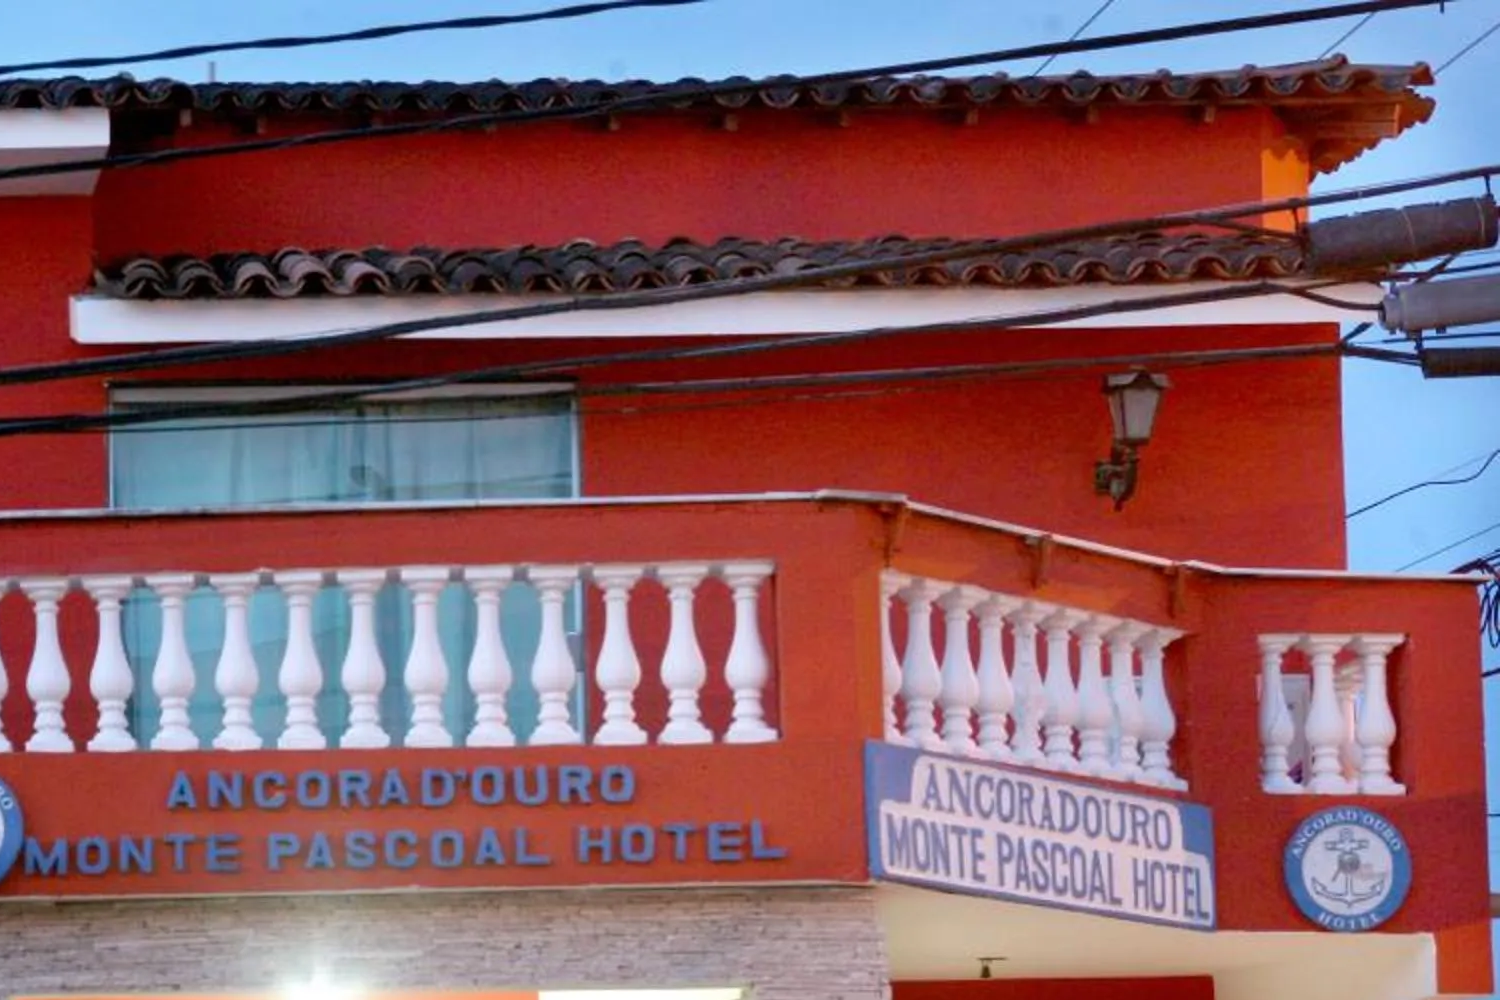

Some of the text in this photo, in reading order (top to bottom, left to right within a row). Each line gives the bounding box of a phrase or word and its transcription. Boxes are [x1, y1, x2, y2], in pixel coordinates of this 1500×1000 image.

[166, 764, 637, 809] ANCORAD'OURO
[921, 763, 1172, 852] ANCORADOURO
[23, 818, 789, 875] MONTE PASCOAL HOTEL
[884, 812, 1211, 921] MONTE PASCOAL HOTEL
[1318, 911, 1381, 930] HOTEL
